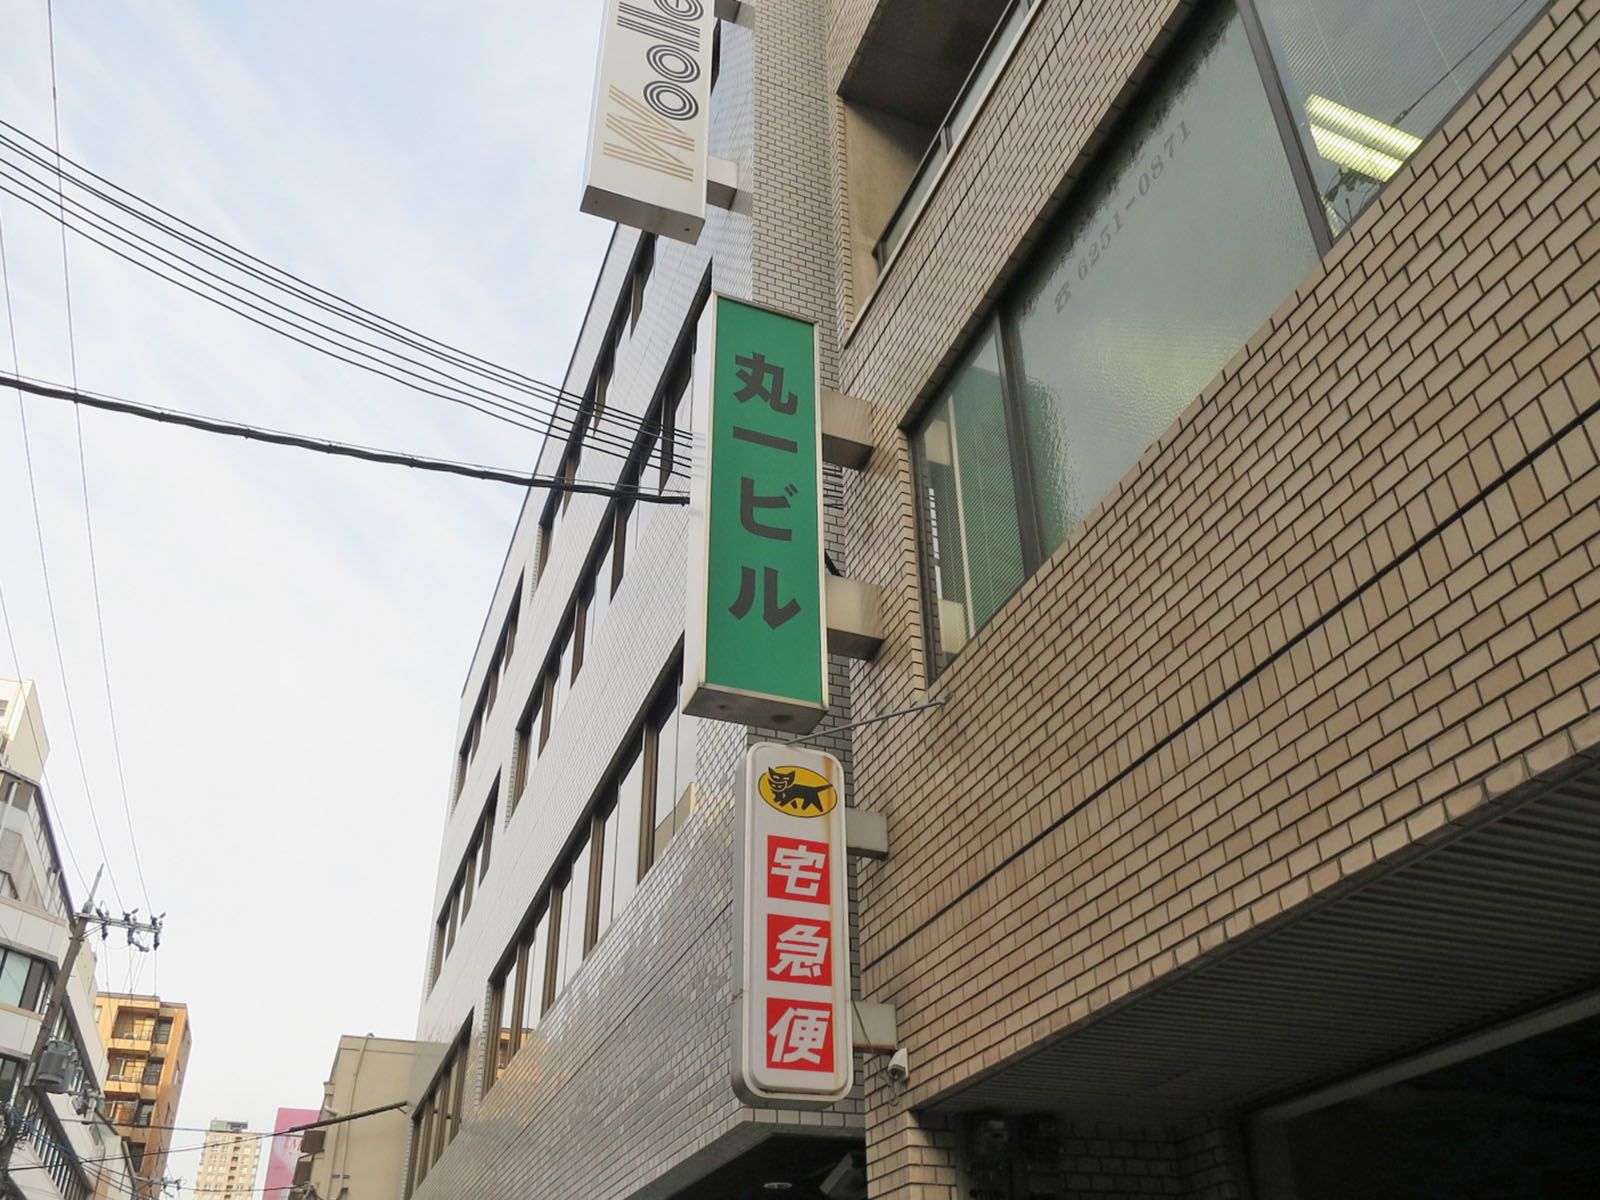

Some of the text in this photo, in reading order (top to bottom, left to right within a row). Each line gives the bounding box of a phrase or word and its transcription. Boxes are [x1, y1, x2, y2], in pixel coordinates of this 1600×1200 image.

[1077, 119, 1191, 281] 6251-0871
[728, 351, 802, 630] 丸一ビル
[768, 844, 832, 1065] 宅急便
